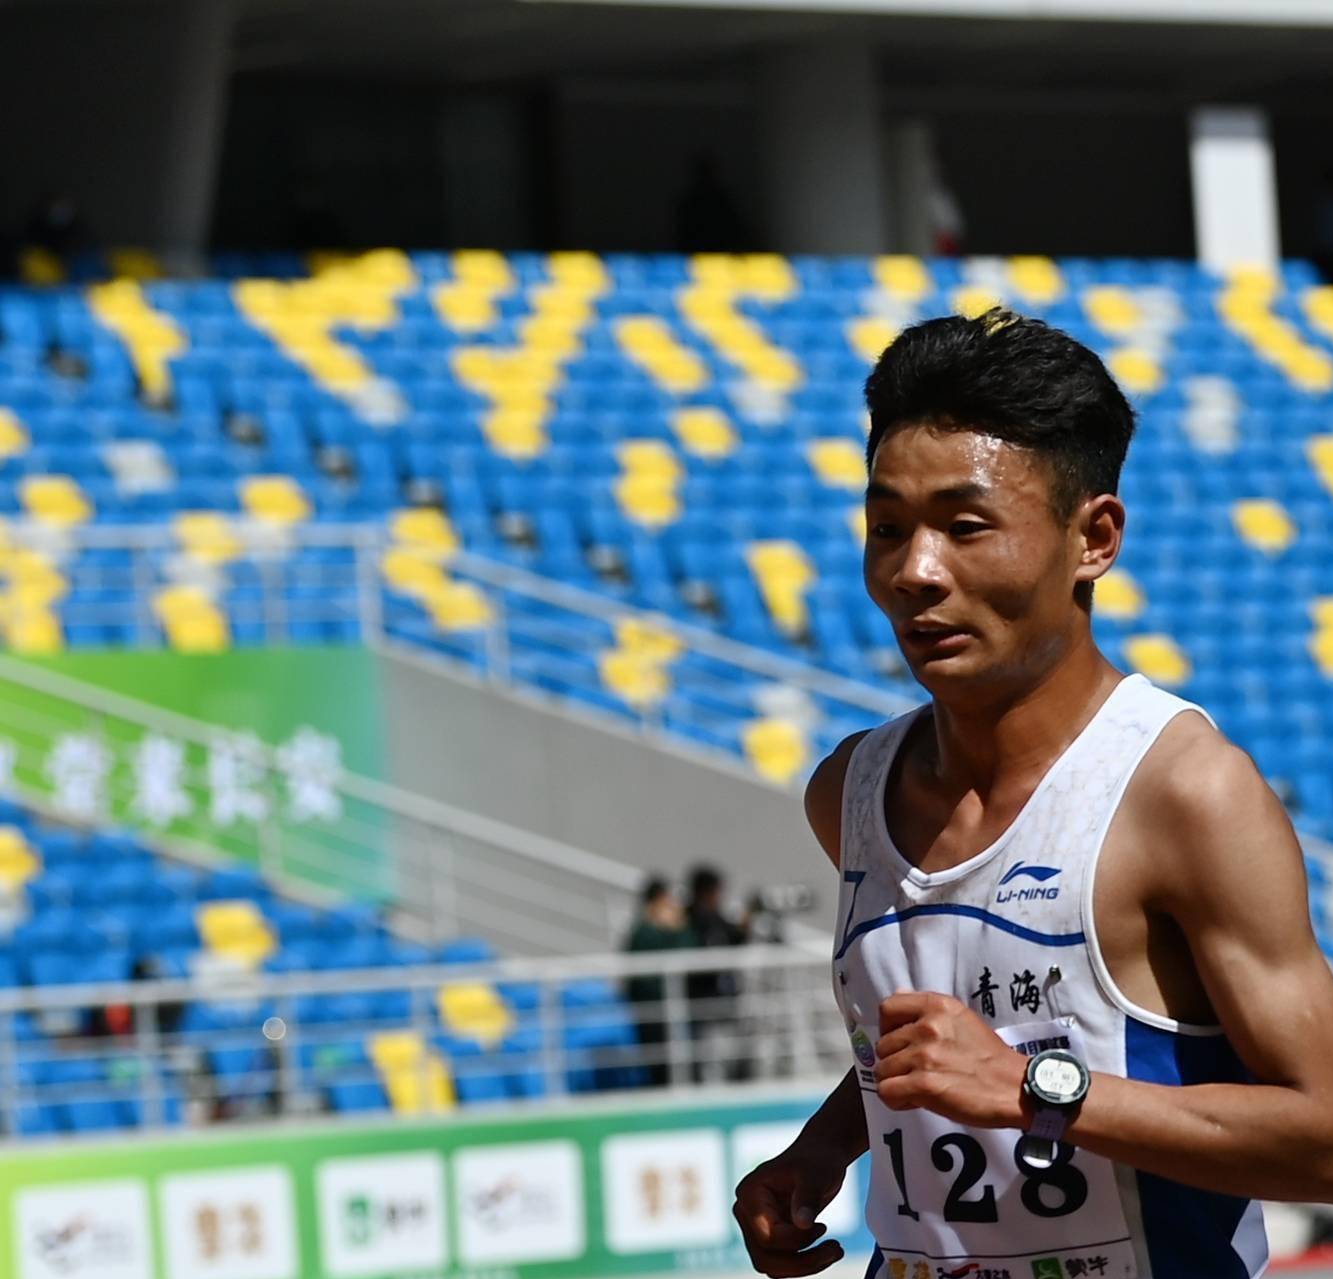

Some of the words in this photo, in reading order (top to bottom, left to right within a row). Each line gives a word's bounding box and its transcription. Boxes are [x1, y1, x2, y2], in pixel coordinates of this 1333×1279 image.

[996, 887, 1059, 903] LI-NING
[971, 966, 1042, 1018] 青海
[883, 1128, 1088, 1223] 128
